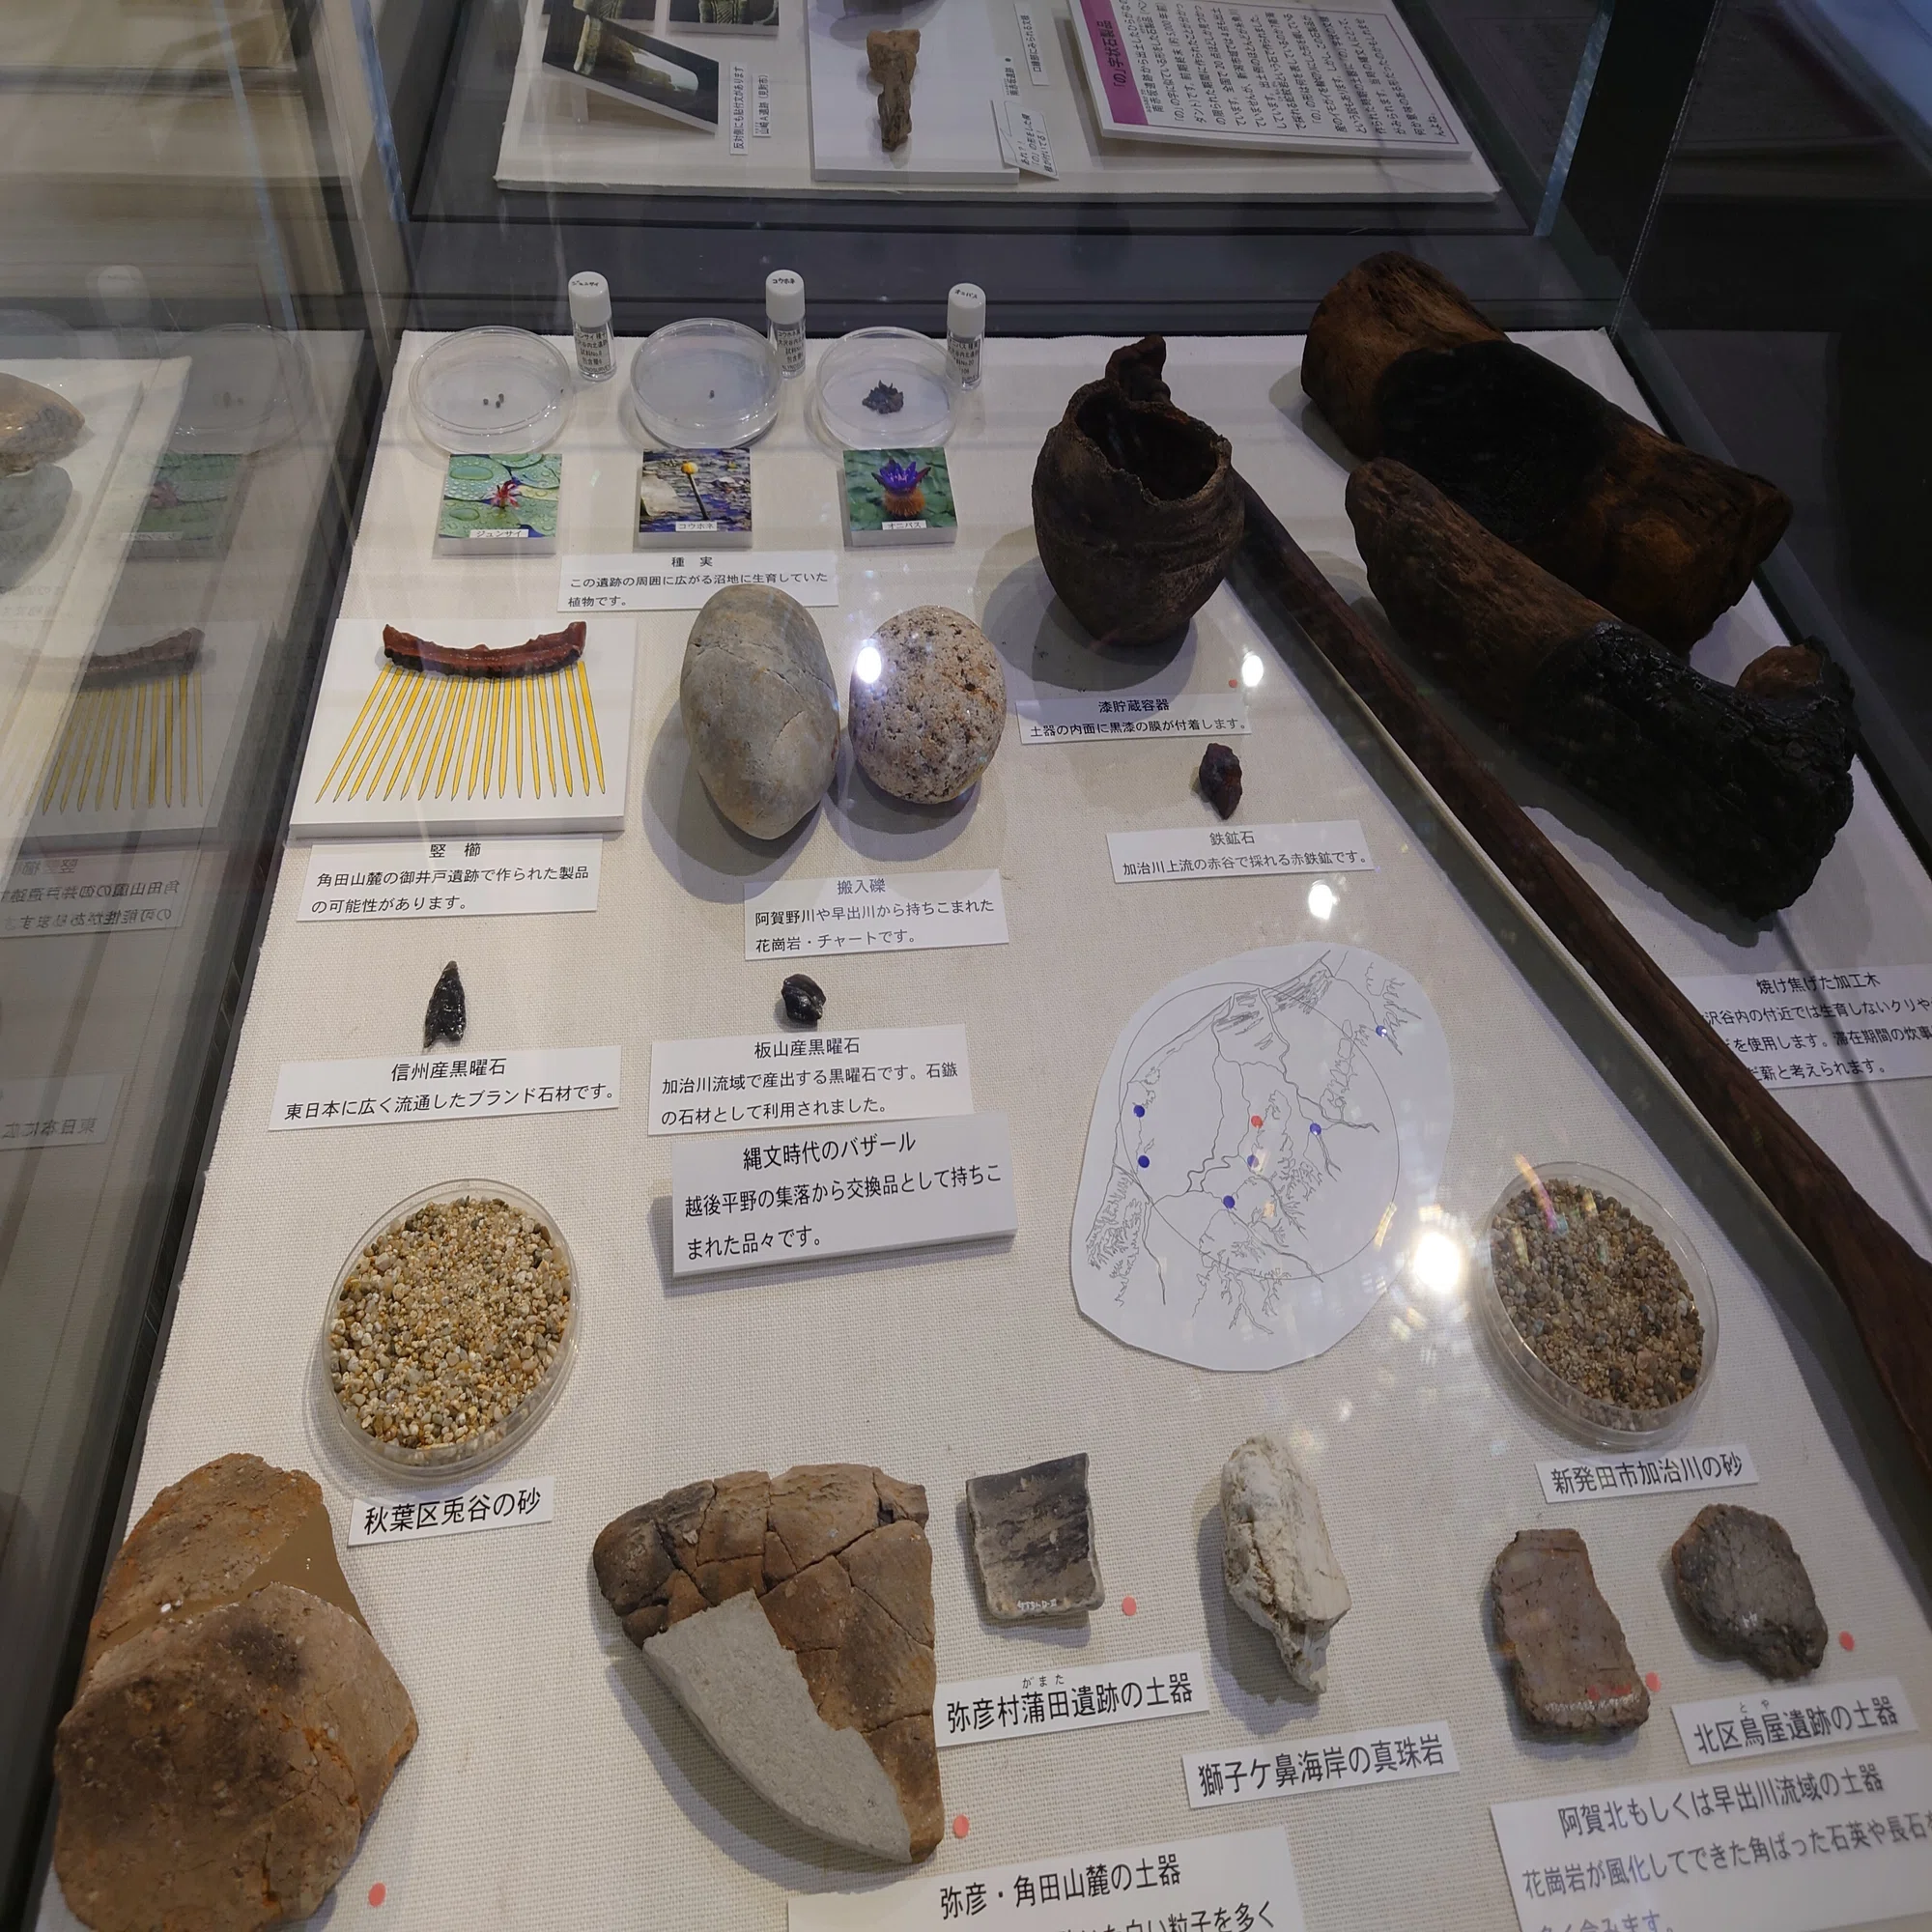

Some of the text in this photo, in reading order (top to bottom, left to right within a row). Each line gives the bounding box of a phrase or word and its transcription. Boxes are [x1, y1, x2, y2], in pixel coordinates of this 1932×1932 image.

[1094, 18, 1131, 87] 「の」字状石製品
[670, 556, 713, 568] 種 実
[570, 572, 829, 588] この遺跡の周囲に広がる沼地に生育していた
[568, 595, 627, 609] 植物です。
[1097, 698, 1171, 714] 漆貯蔵容器
[1030, 717, 1246, 738] 土器の内面に黒漆の膜が付着します。
[1209, 831, 1256, 846] 鉄鉱石
[317, 866, 589, 888] 角田山麓の御井戸遺跡で作られた製品
[1122, 850, 1367, 876] 加治川上流の赤谷で採れる赤鉄鉱です。
[837, 877, 887, 895] 搬入礫
[311, 895, 469, 915] の可能性があります。
[754, 898, 995, 927] 阿賀野川や早出川から持ちこまれた
[755, 928, 917, 953] 花崗岩・チャートです。
[1756, 972, 1882, 995] 焼け焦げた加工木
[1702, 998, 1932, 1026] 沢谷内の付近では生育しないクリや
[753, 1036, 861, 1060] 板山産黒曜石
[1725, 1025, 1932, 1053] を使用します。滞在期間の炊事
[390, 1057, 507, 1083] 信州産黒曜石
[661, 1061, 958, 1095] 加治川流域で産出する黒曜石です。石鏃
[284, 1083, 615, 1122] 東日本に広く流通したブランド石材です。
[661, 1095, 887, 1127] の石材として利用されました。
[743, 1131, 916, 1172] 縄文時代のバザール
[684, 1163, 1002, 1219] 越後平野の集落から交換品として持ちこ
[687, 1223, 821, 1261] まれた品々です。
[1551, 1451, 1743, 1495] 新発田市加治川の砂
[363, 1486, 541, 1536] 秋葉区兎谷の砂
[947, 1671, 1193, 1734] 弥彦村蒲田遺跡の土器
[1693, 1695, 1899, 1754] 北区鳥屋遺跡の土器
[1557, 1764, 1884, 1838] 阿賀北もしくは早出川流域の土器
[940, 1853, 1181, 1920] 弥彦・角田山麓の土器
